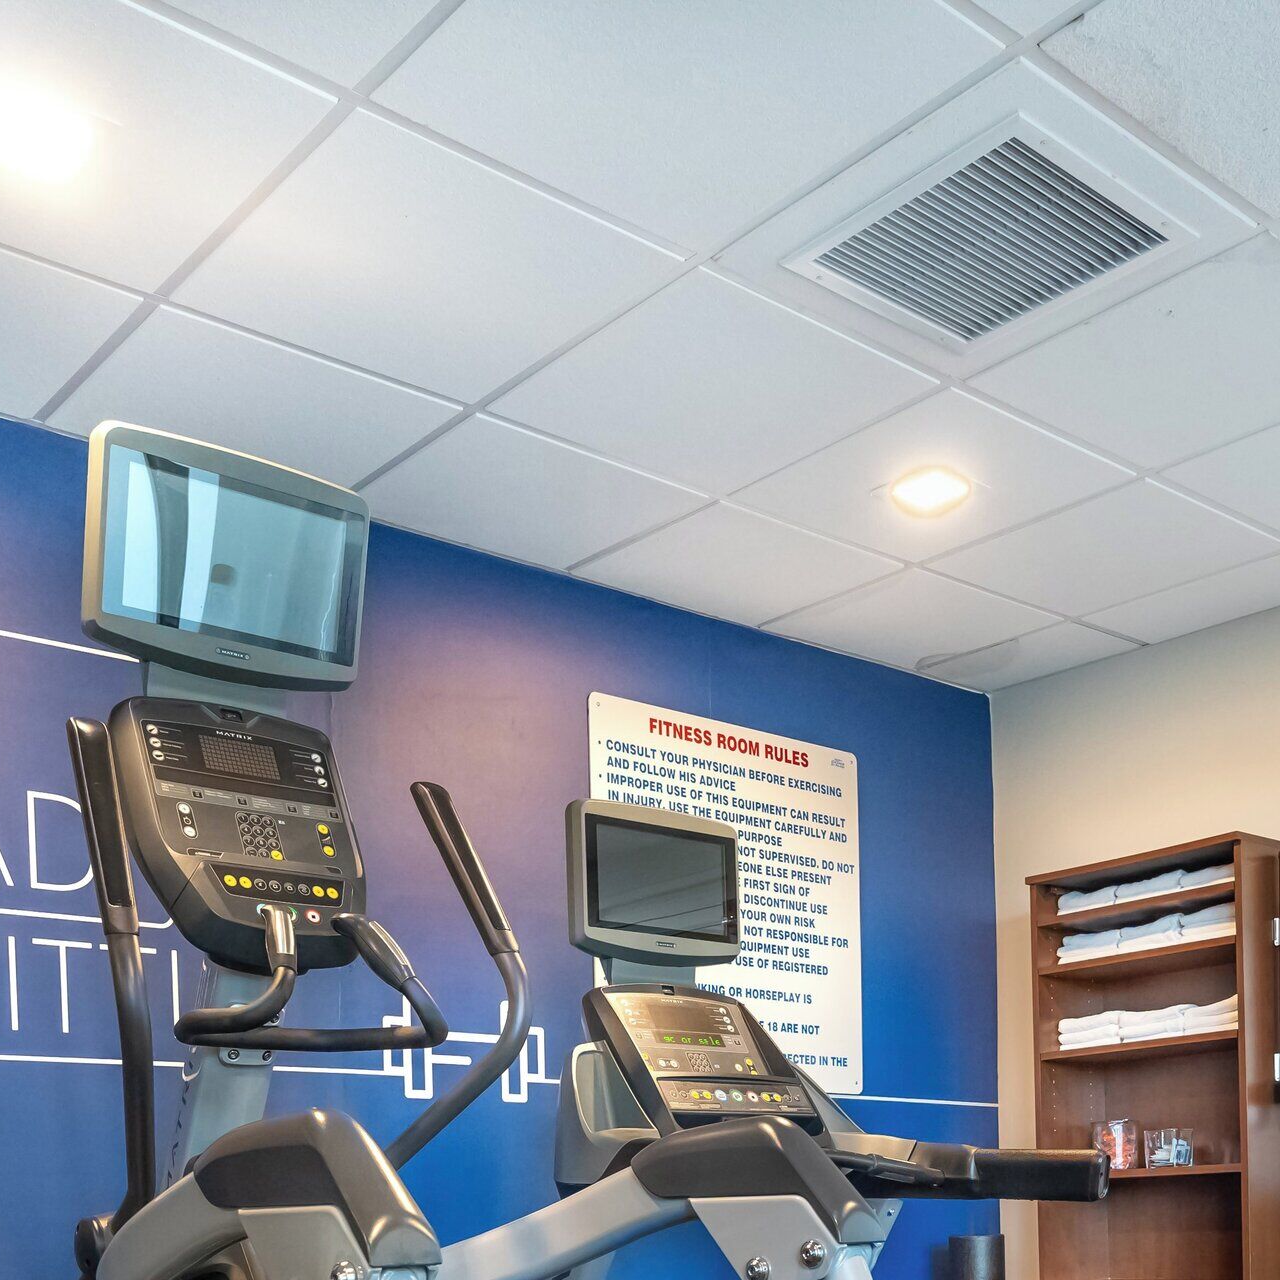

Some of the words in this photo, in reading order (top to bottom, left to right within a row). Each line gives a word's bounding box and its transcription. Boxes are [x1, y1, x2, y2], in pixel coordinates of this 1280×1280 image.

[216, 730, 253, 741] MATRIX
[649, 717, 713, 747] FITNESS
[717, 732, 760, 757] ROOM
[765, 743, 809, 768] RULES
[606, 739, 657, 760] CONSULT
[660, 750, 689, 767] YOUR
[692, 757, 746, 778] PHYSICIAN
[749, 769, 785, 787] BEFORE
[788, 777, 842, 798] EXERCISING
[606, 756, 630, 770] AND
[633, 761, 676, 780] FOLLOW
[679, 770, 696, 784] HIS
[699, 775, 736, 792] ADVICE
[607, 772, 663, 793] IMPROPER
[666, 784, 687, 798] USE
[690, 789, 703, 801] OF
[706, 792, 729, 806] THIS
[732, 797, 788, 817] EQUIPMENT
[790, 808, 809, 821] CAN
[812, 812, 846, 828] RESULT
[608, 789, 619, 801] IN
[669, 800, 689, 814] USE
[692, 805, 712, 819] THE
[715, 809, 772, 830] EQUIPMENT
[774, 821, 827, 840] CAREFULLY
[829, 831, 848, 843] AND
[738, 829, 783, 847] PURPOSE
[738, 845, 756, 858] NOT
[822, 860, 834, 871] DO
[837, 862, 855, 875] NOT
[738, 861, 762, 875] EONE
[766, 865, 788, 879] ELSE
[791, 869, 832, 886] PRESENT
[744, 878, 770, 892] FIRST
[773, 882, 796, 896] SIGN
[798, 886, 811, 897] OF
[744, 893, 808, 912] DISCONTINUE
[810, 902, 828, 915] USE
[740, 908, 767, 922] YOUR
[769, 913, 791, 925] OWN
[794, 916, 816, 929] RISK
[743, 925, 764, 937] NOT
[766, 928, 829, 946] RESPONSIBLE
[831, 937, 849, 949] FOR
[740, 940, 790, 956] QUIPMENT
[792, 946, 810, 959] USE
[735, 955, 754, 967] USE
[757, 958, 769, 969] OF
[772, 959, 829, 976] REGISTERED
[728, 986, 742, 998] OR
[745, 987, 801, 1004] HORSEPLAY
[803, 994, 813, 1005] IS
[767, 1021, 778, 1032] 18
[780, 1022, 799, 1034] ARE
[801, 1024, 820, 1036] NOT
[819, 1055, 829, 1066] IN
[830, 1056, 848, 1067] THE
